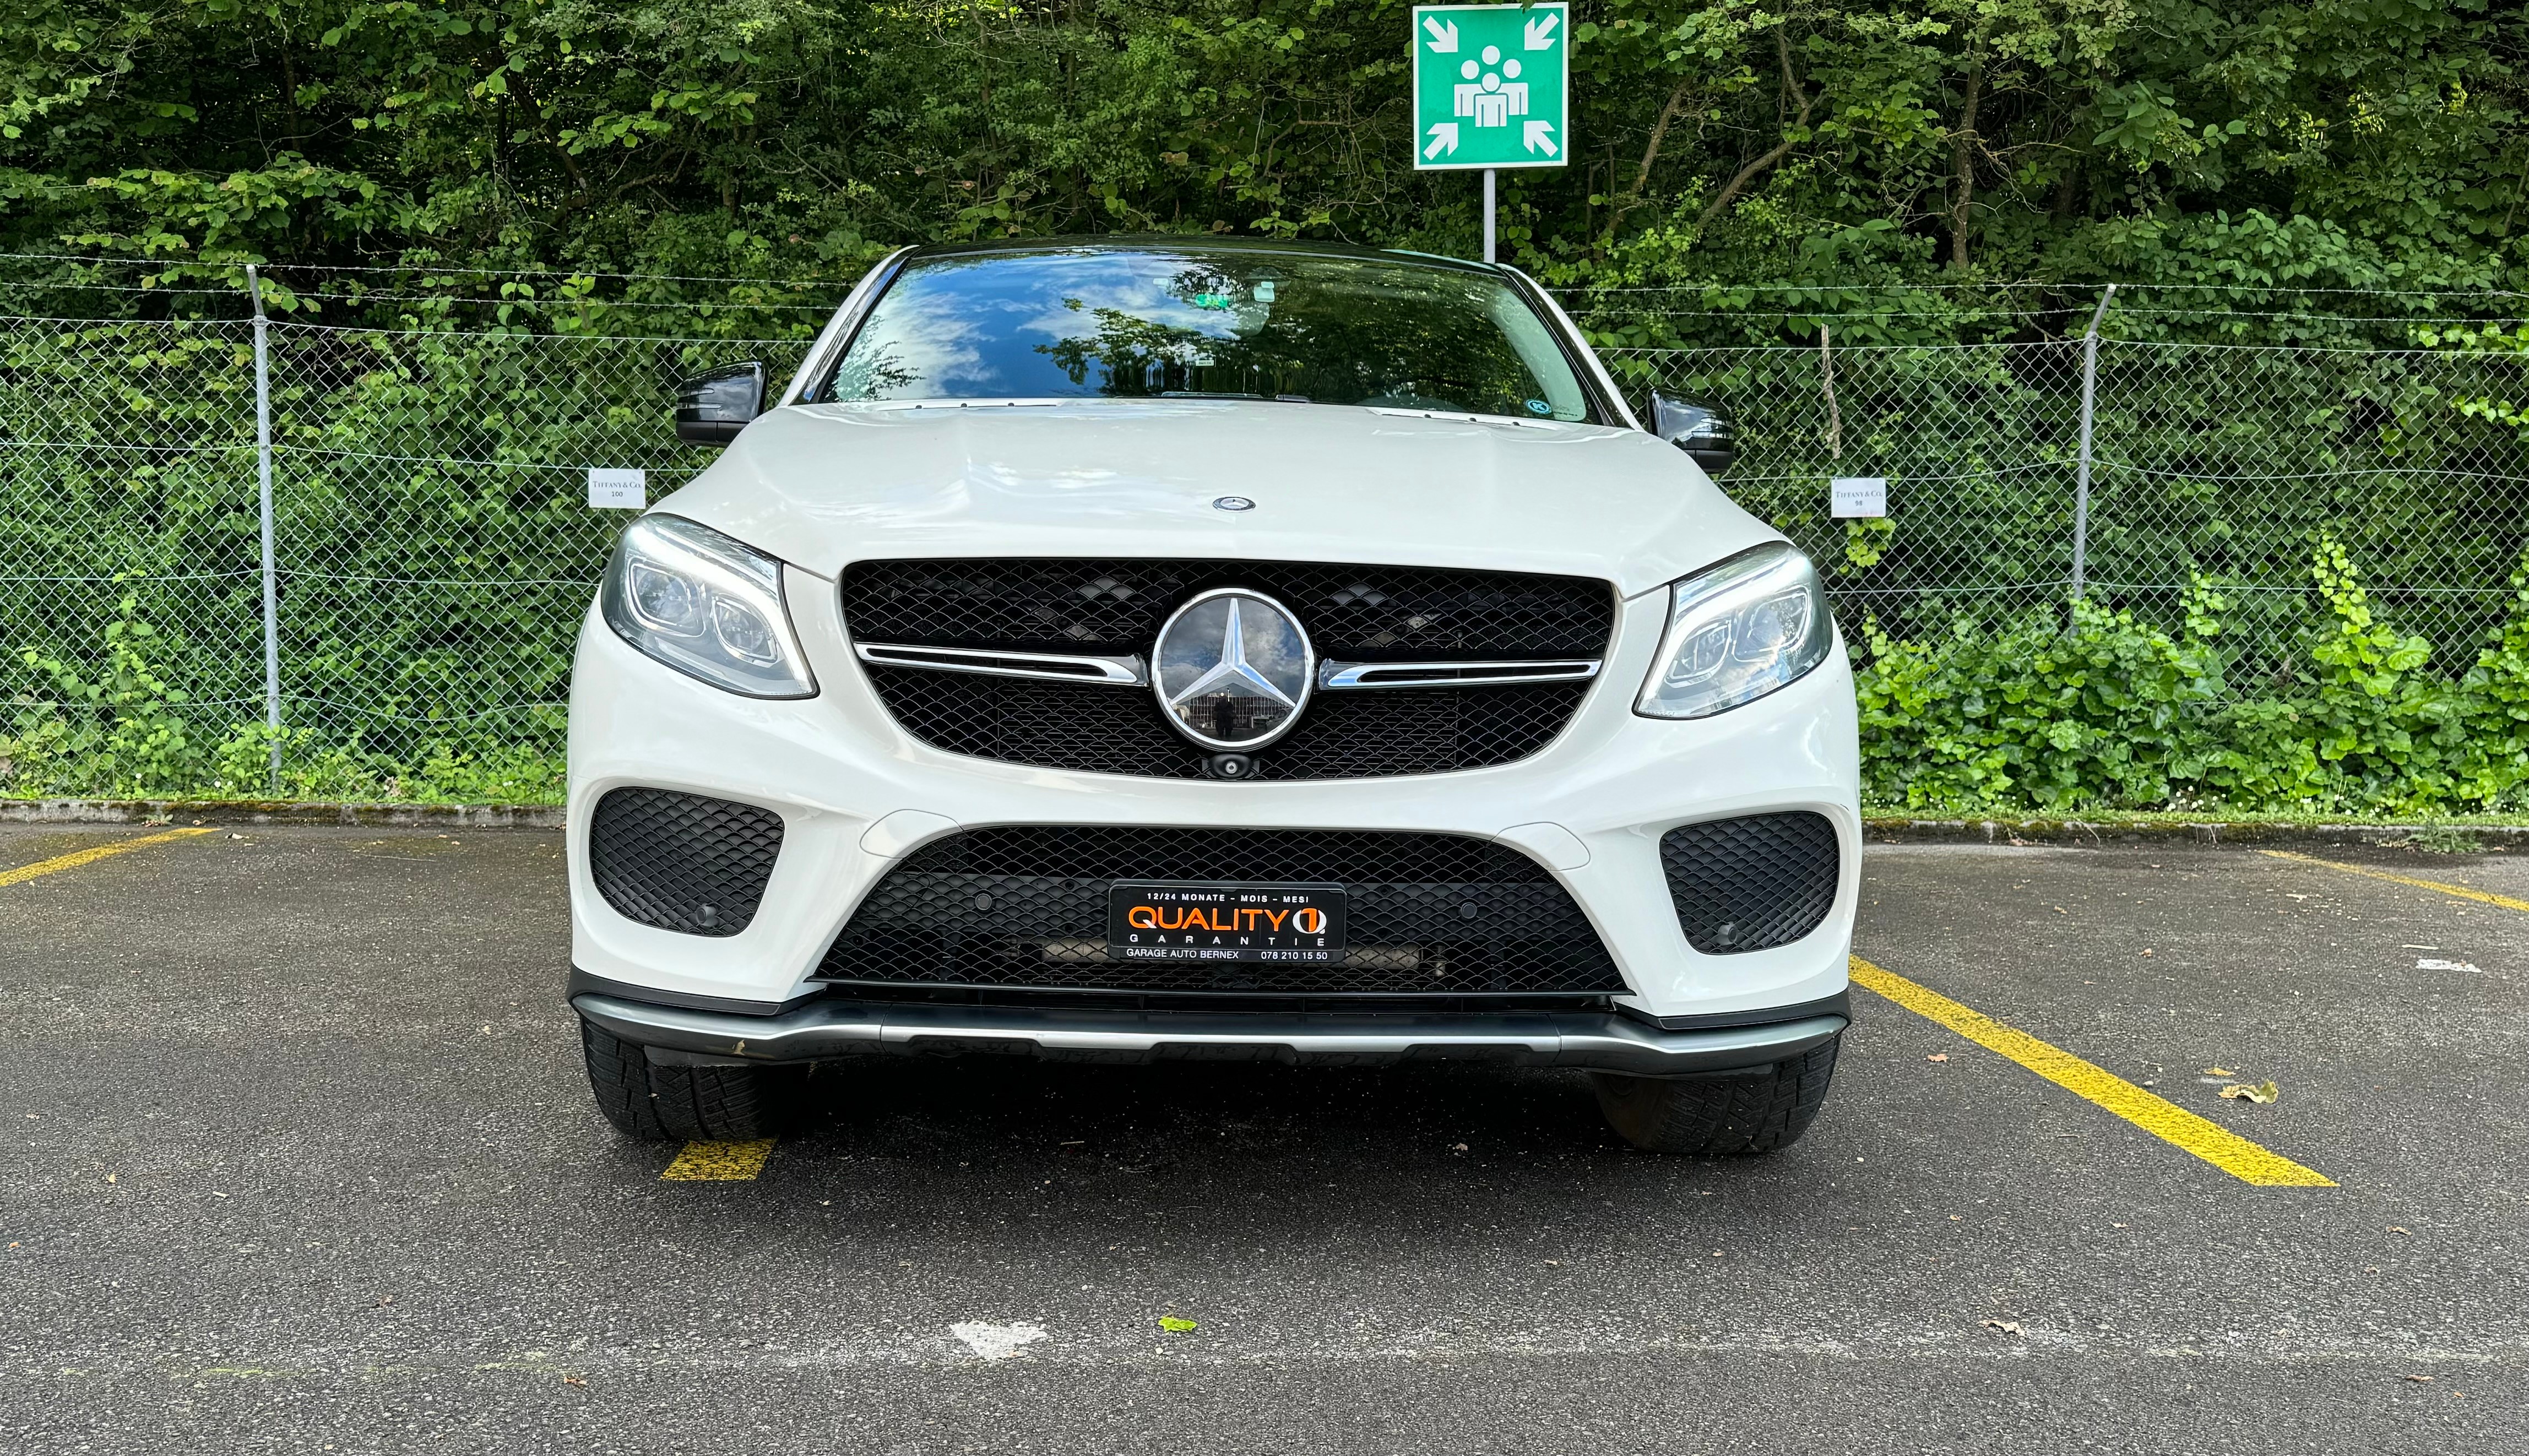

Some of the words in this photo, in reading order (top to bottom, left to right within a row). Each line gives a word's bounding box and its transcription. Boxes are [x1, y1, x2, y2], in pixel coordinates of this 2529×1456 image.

[1181, 893, 1225, 901] MONATE
[1240, 894, 1268, 903] MOIS
[1128, 906, 1290, 932] QUALITY
[1129, 934, 1325, 947] GARANTIE
[1126, 948, 1168, 958] GARAGE
[1170, 949, 1197, 958] AUTO
[1200, 950, 1239, 959] BERNEX
[1261, 951, 1278, 960] 078
[1281, 952, 1299, 960] 210
[1303, 952, 1314, 960] 15
[1316, 952, 1328, 960] 50
